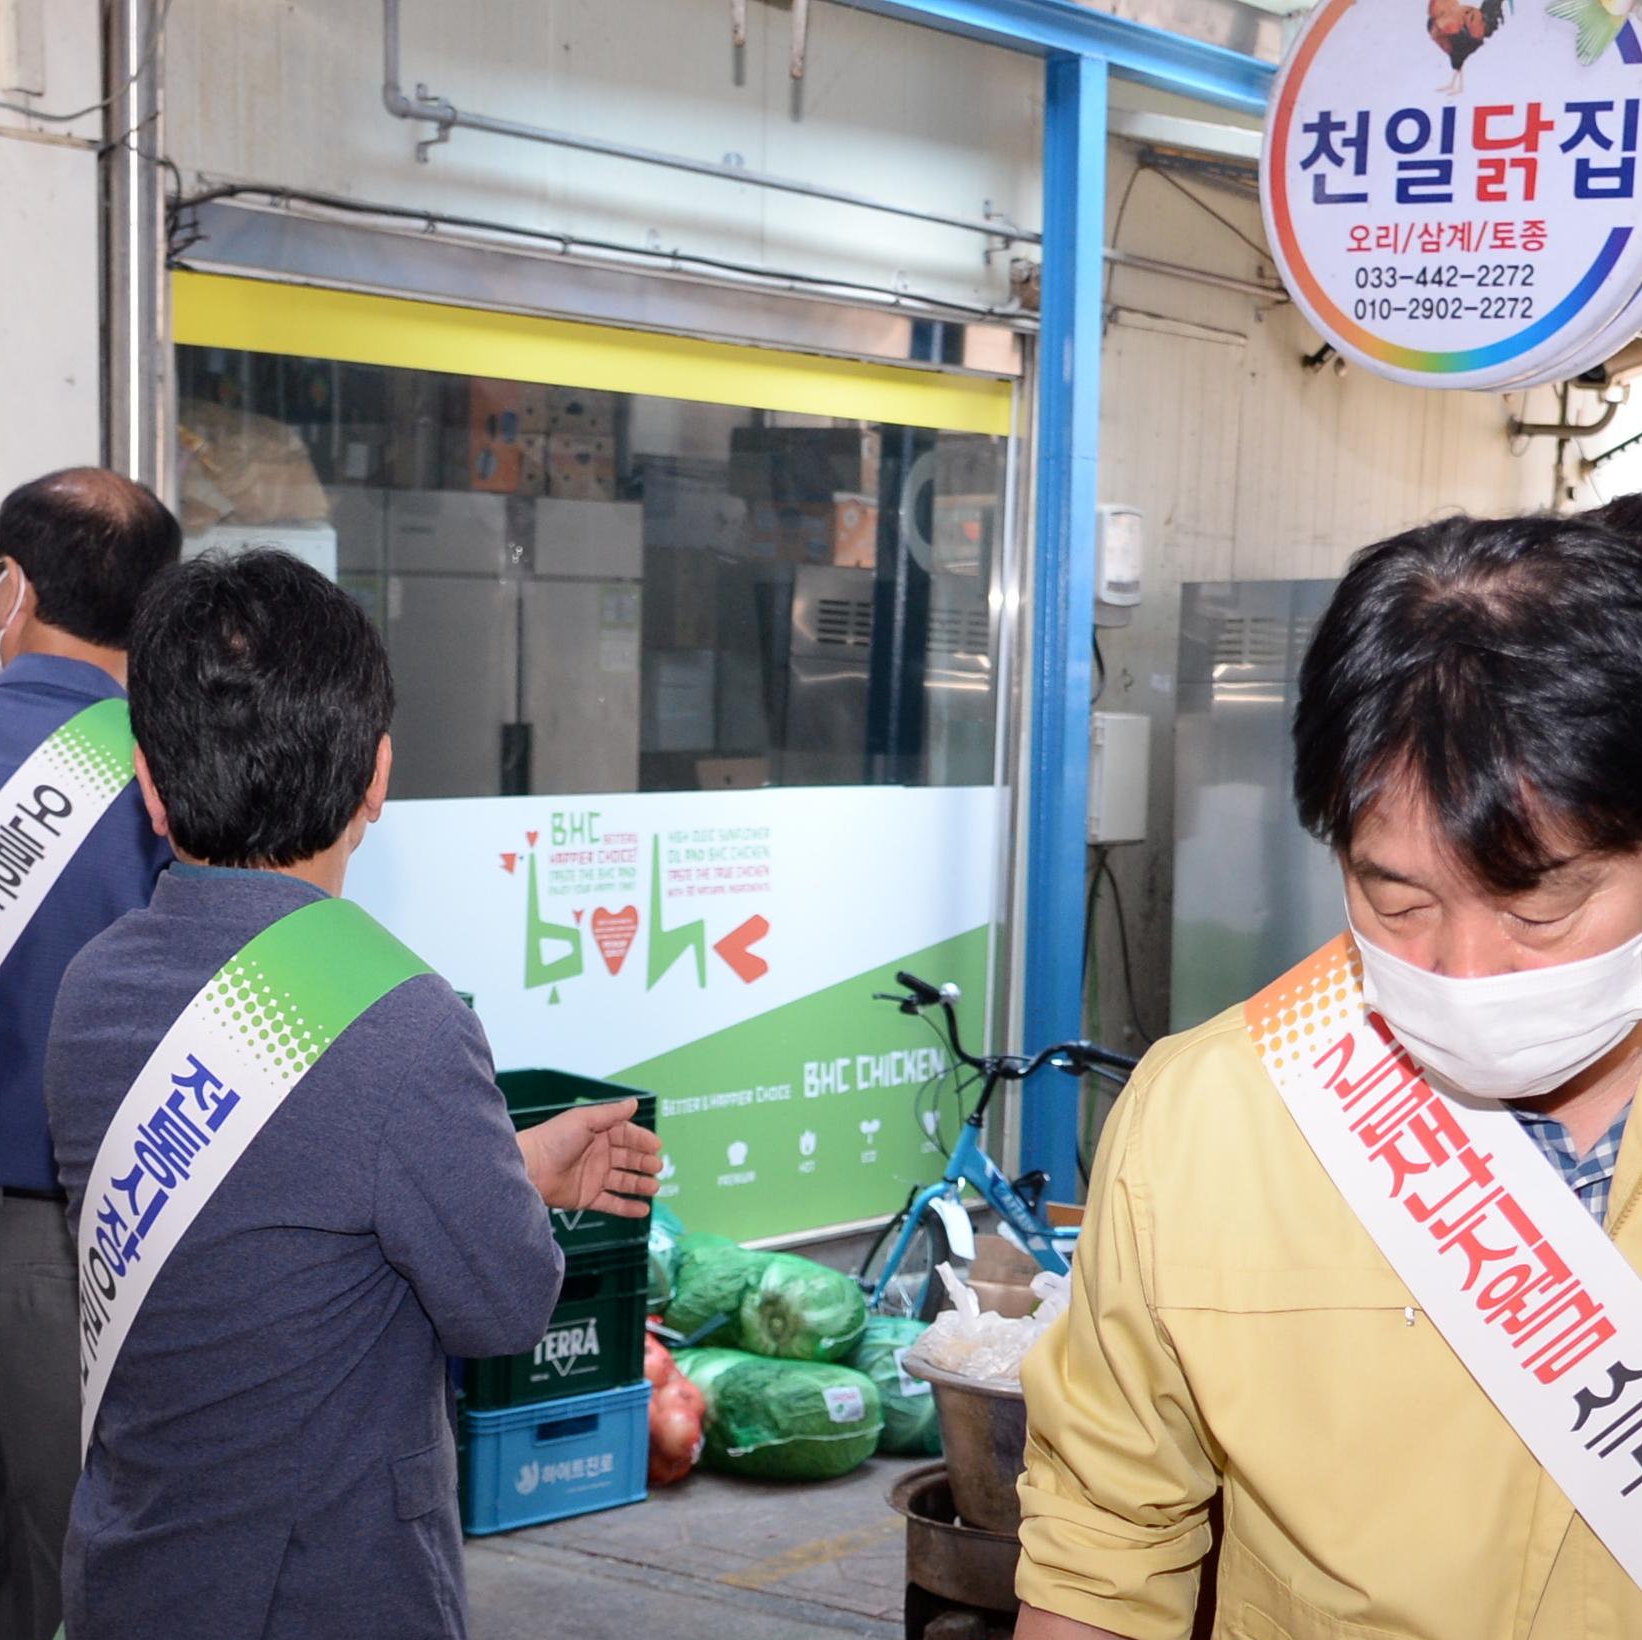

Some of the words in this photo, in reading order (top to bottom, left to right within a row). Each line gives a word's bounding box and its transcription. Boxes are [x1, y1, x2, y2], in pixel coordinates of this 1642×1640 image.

[1299, 97, 1640, 205] 천일닭집
[1346, 218, 1549, 256] 오리/삼계/토종
[1354, 263, 1536, 291] 033-442-2272
[1353, 295, 1535, 322] 010-2902-2272
[552, 811, 601, 846] BHC
[803, 1058, 851, 1099] BHC
[856, 1047, 946, 1091] CHICKEN
[1313, 1012, 1618, 1386] 긴급재난지원금
[532, 1321, 600, 1366] TERRA
